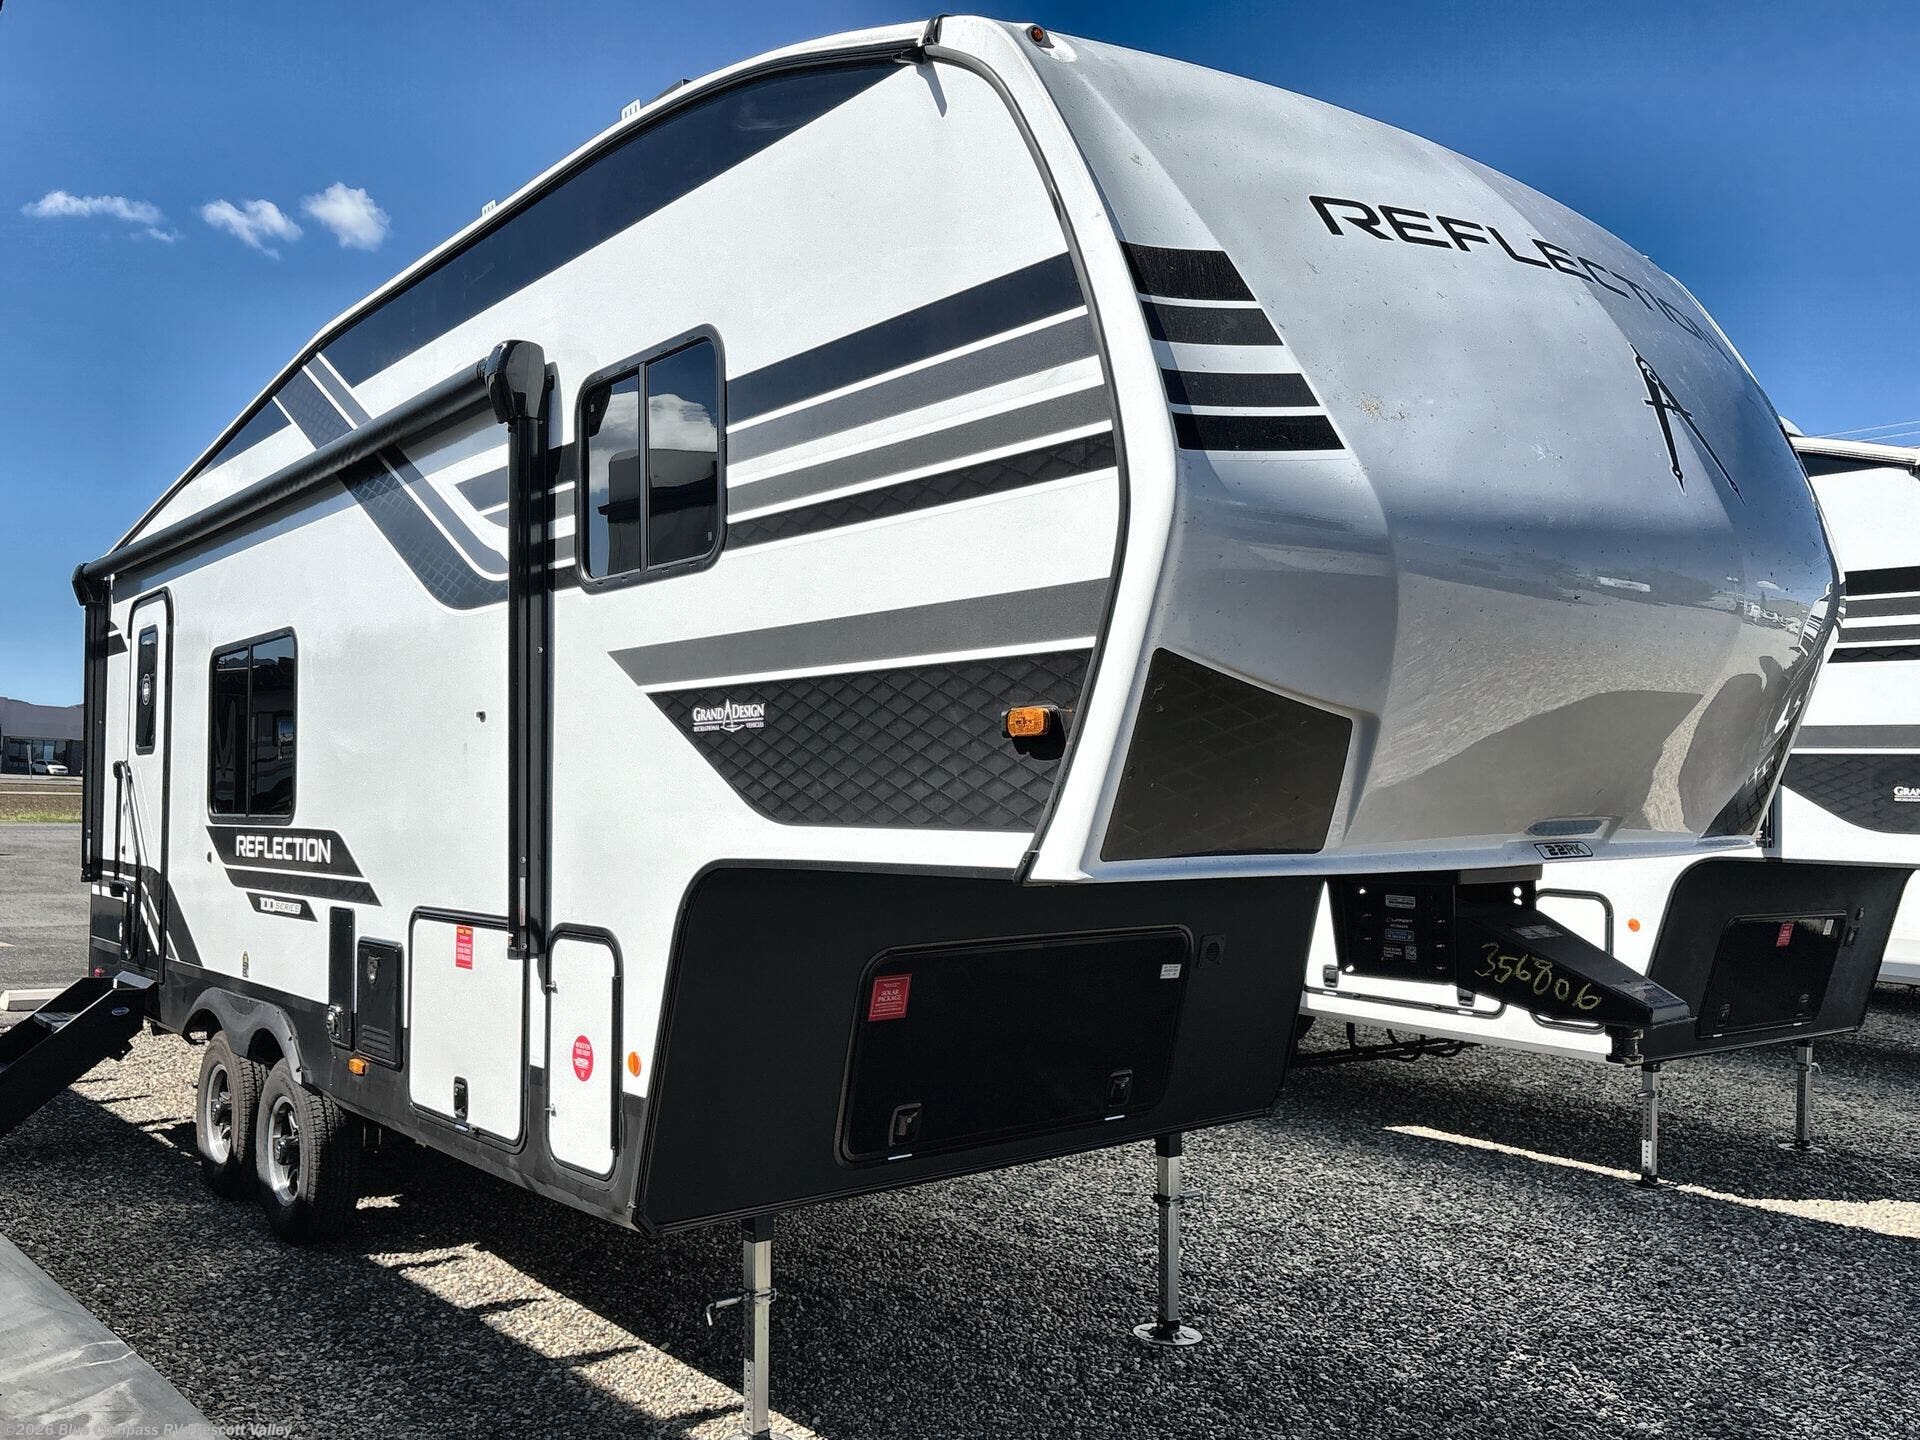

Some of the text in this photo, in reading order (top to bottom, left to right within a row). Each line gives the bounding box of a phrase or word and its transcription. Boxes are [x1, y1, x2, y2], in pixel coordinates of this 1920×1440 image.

[1308, 194, 1733, 365] REFLECTION
[693, 703, 765, 721] GRAND DESIGN
[235, 835, 332, 864] REFLECTION
[275, 901, 301, 914] SERIES
[1474, 942, 1602, 1010] 356806
